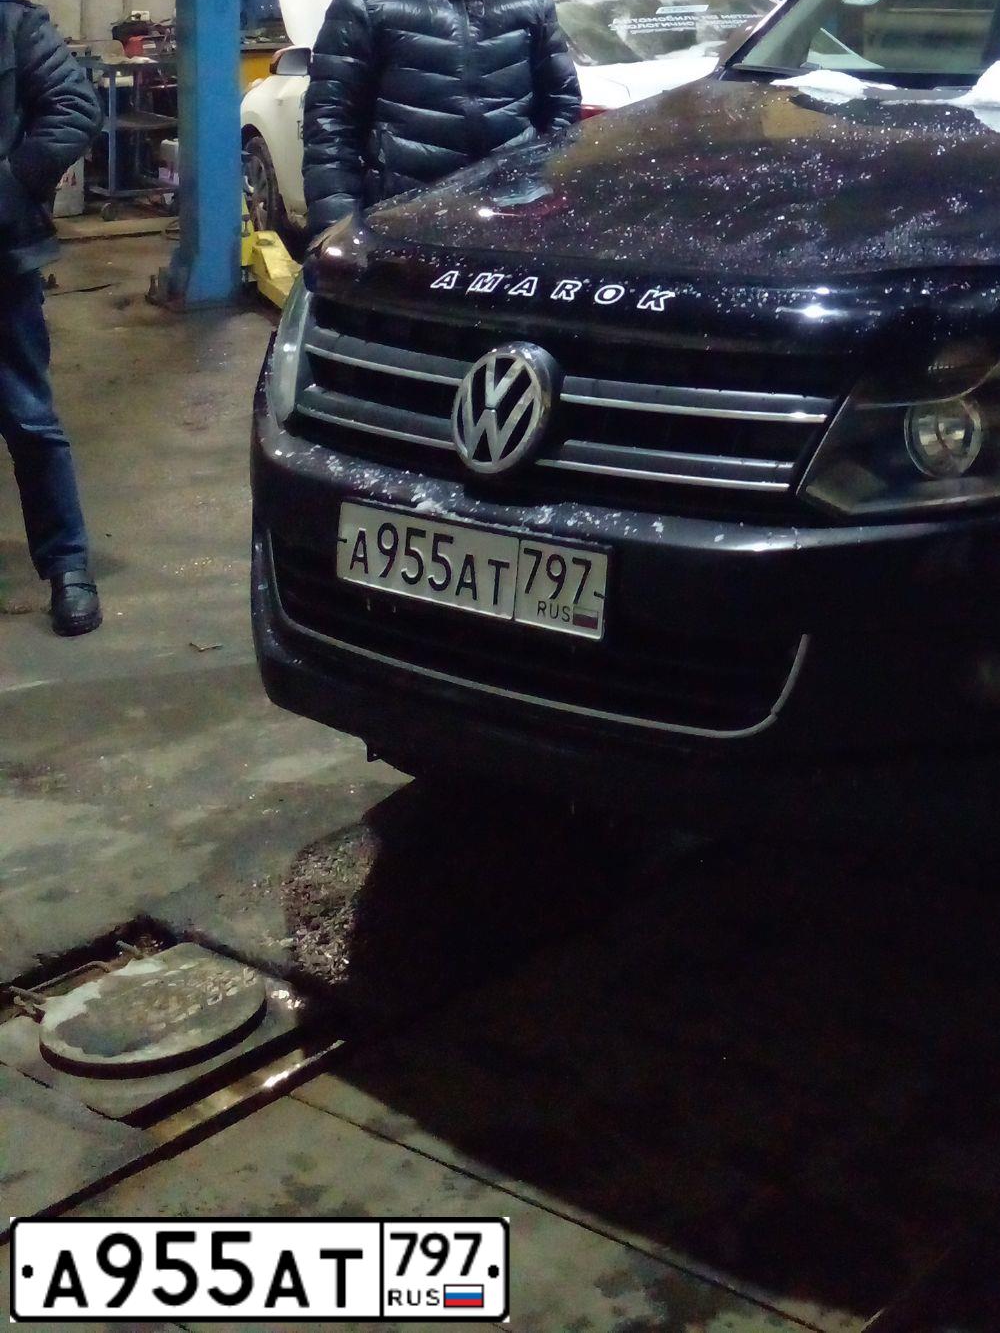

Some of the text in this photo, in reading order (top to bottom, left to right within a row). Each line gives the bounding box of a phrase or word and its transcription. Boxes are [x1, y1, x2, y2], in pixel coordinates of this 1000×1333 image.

[430, 270, 675, 311] AMAROK
[523, 548, 592, 605] 797
[537, 600, 571, 623] RUS
